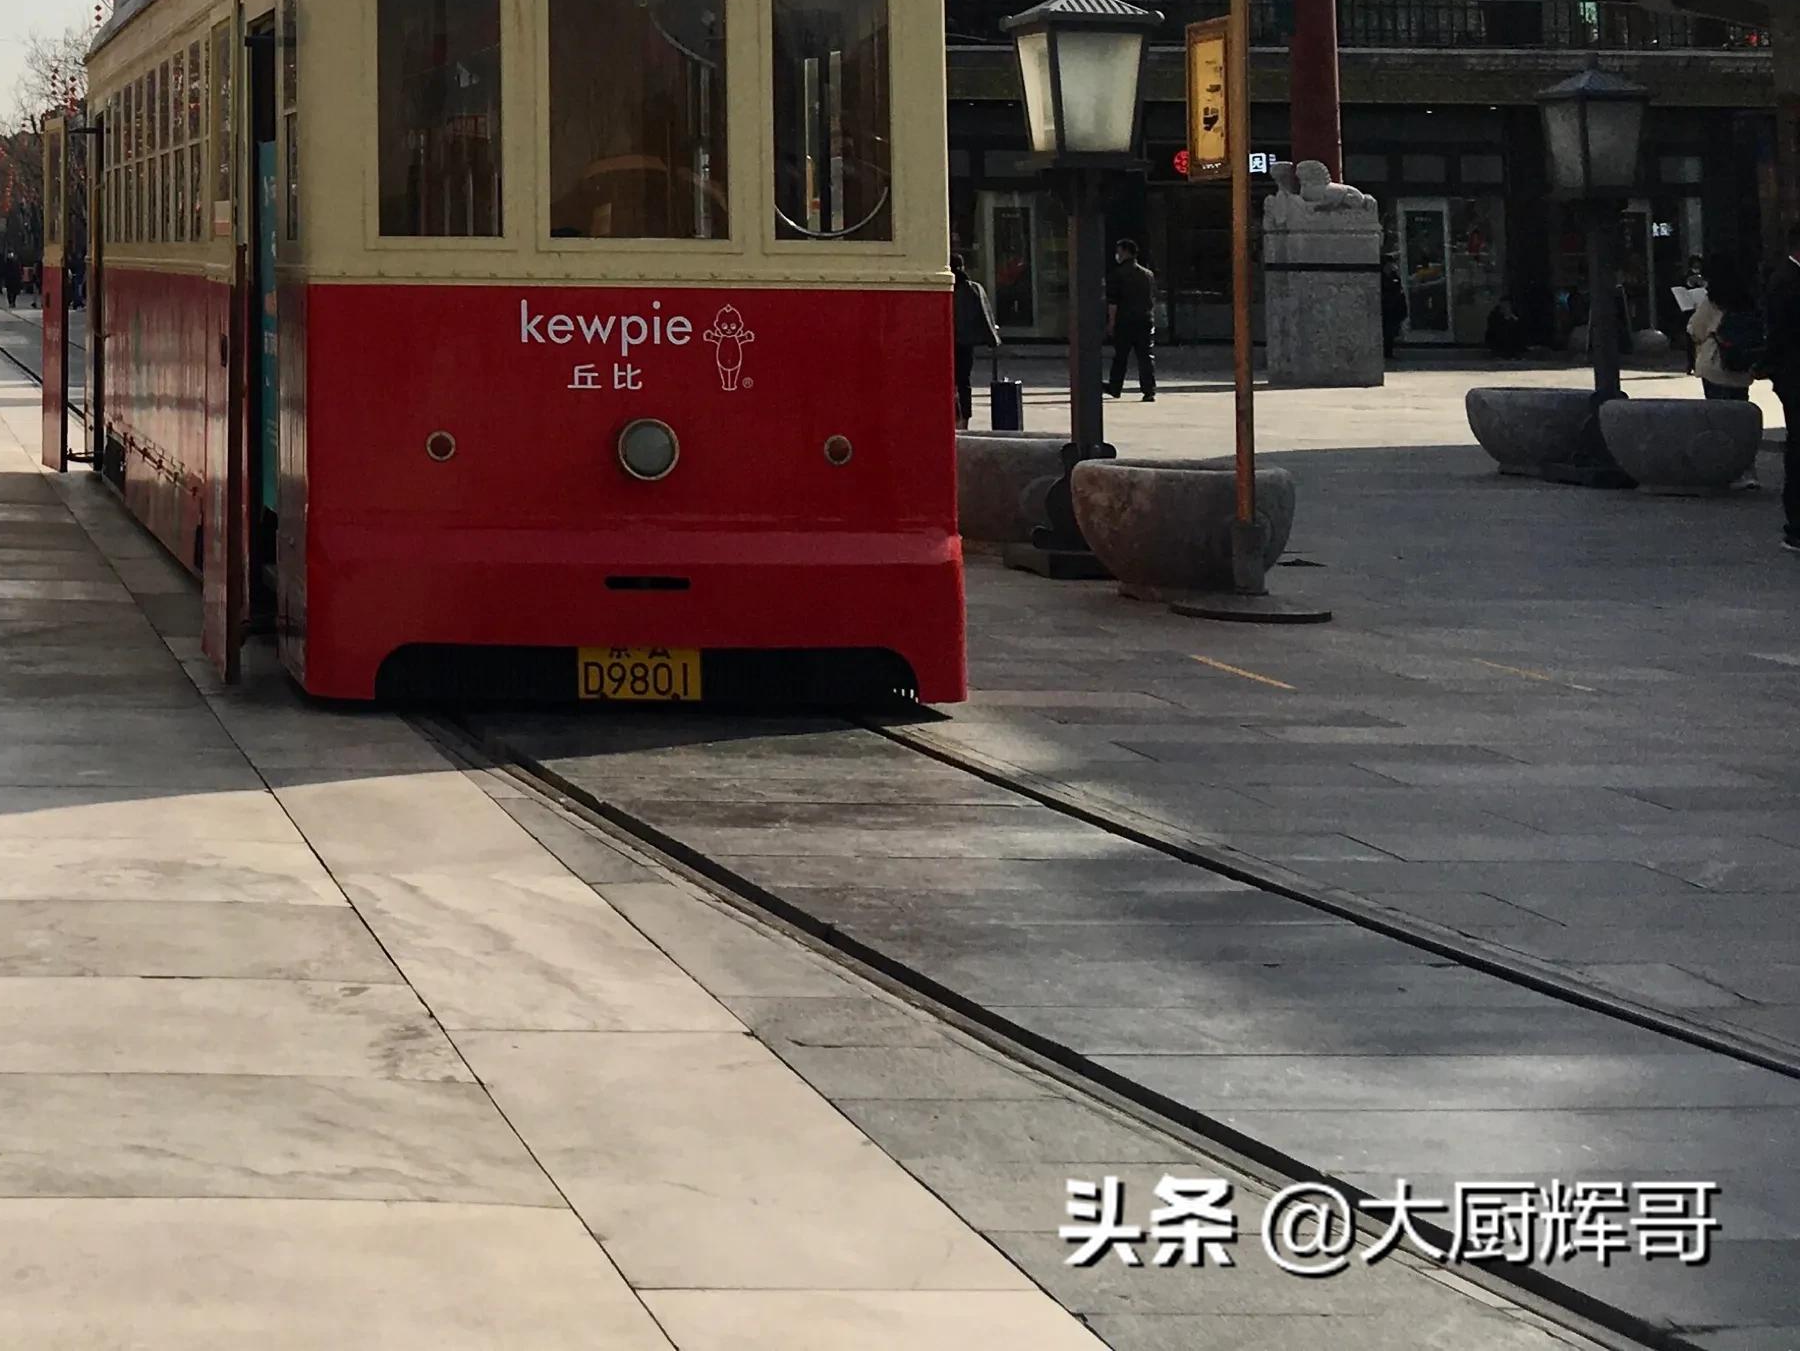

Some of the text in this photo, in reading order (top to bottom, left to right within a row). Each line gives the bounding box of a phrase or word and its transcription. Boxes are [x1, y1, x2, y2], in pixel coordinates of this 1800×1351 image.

[520, 298, 694, 357] kewpie
[566, 362, 643, 391] 丘比
[583, 661, 690, 696] D9801
